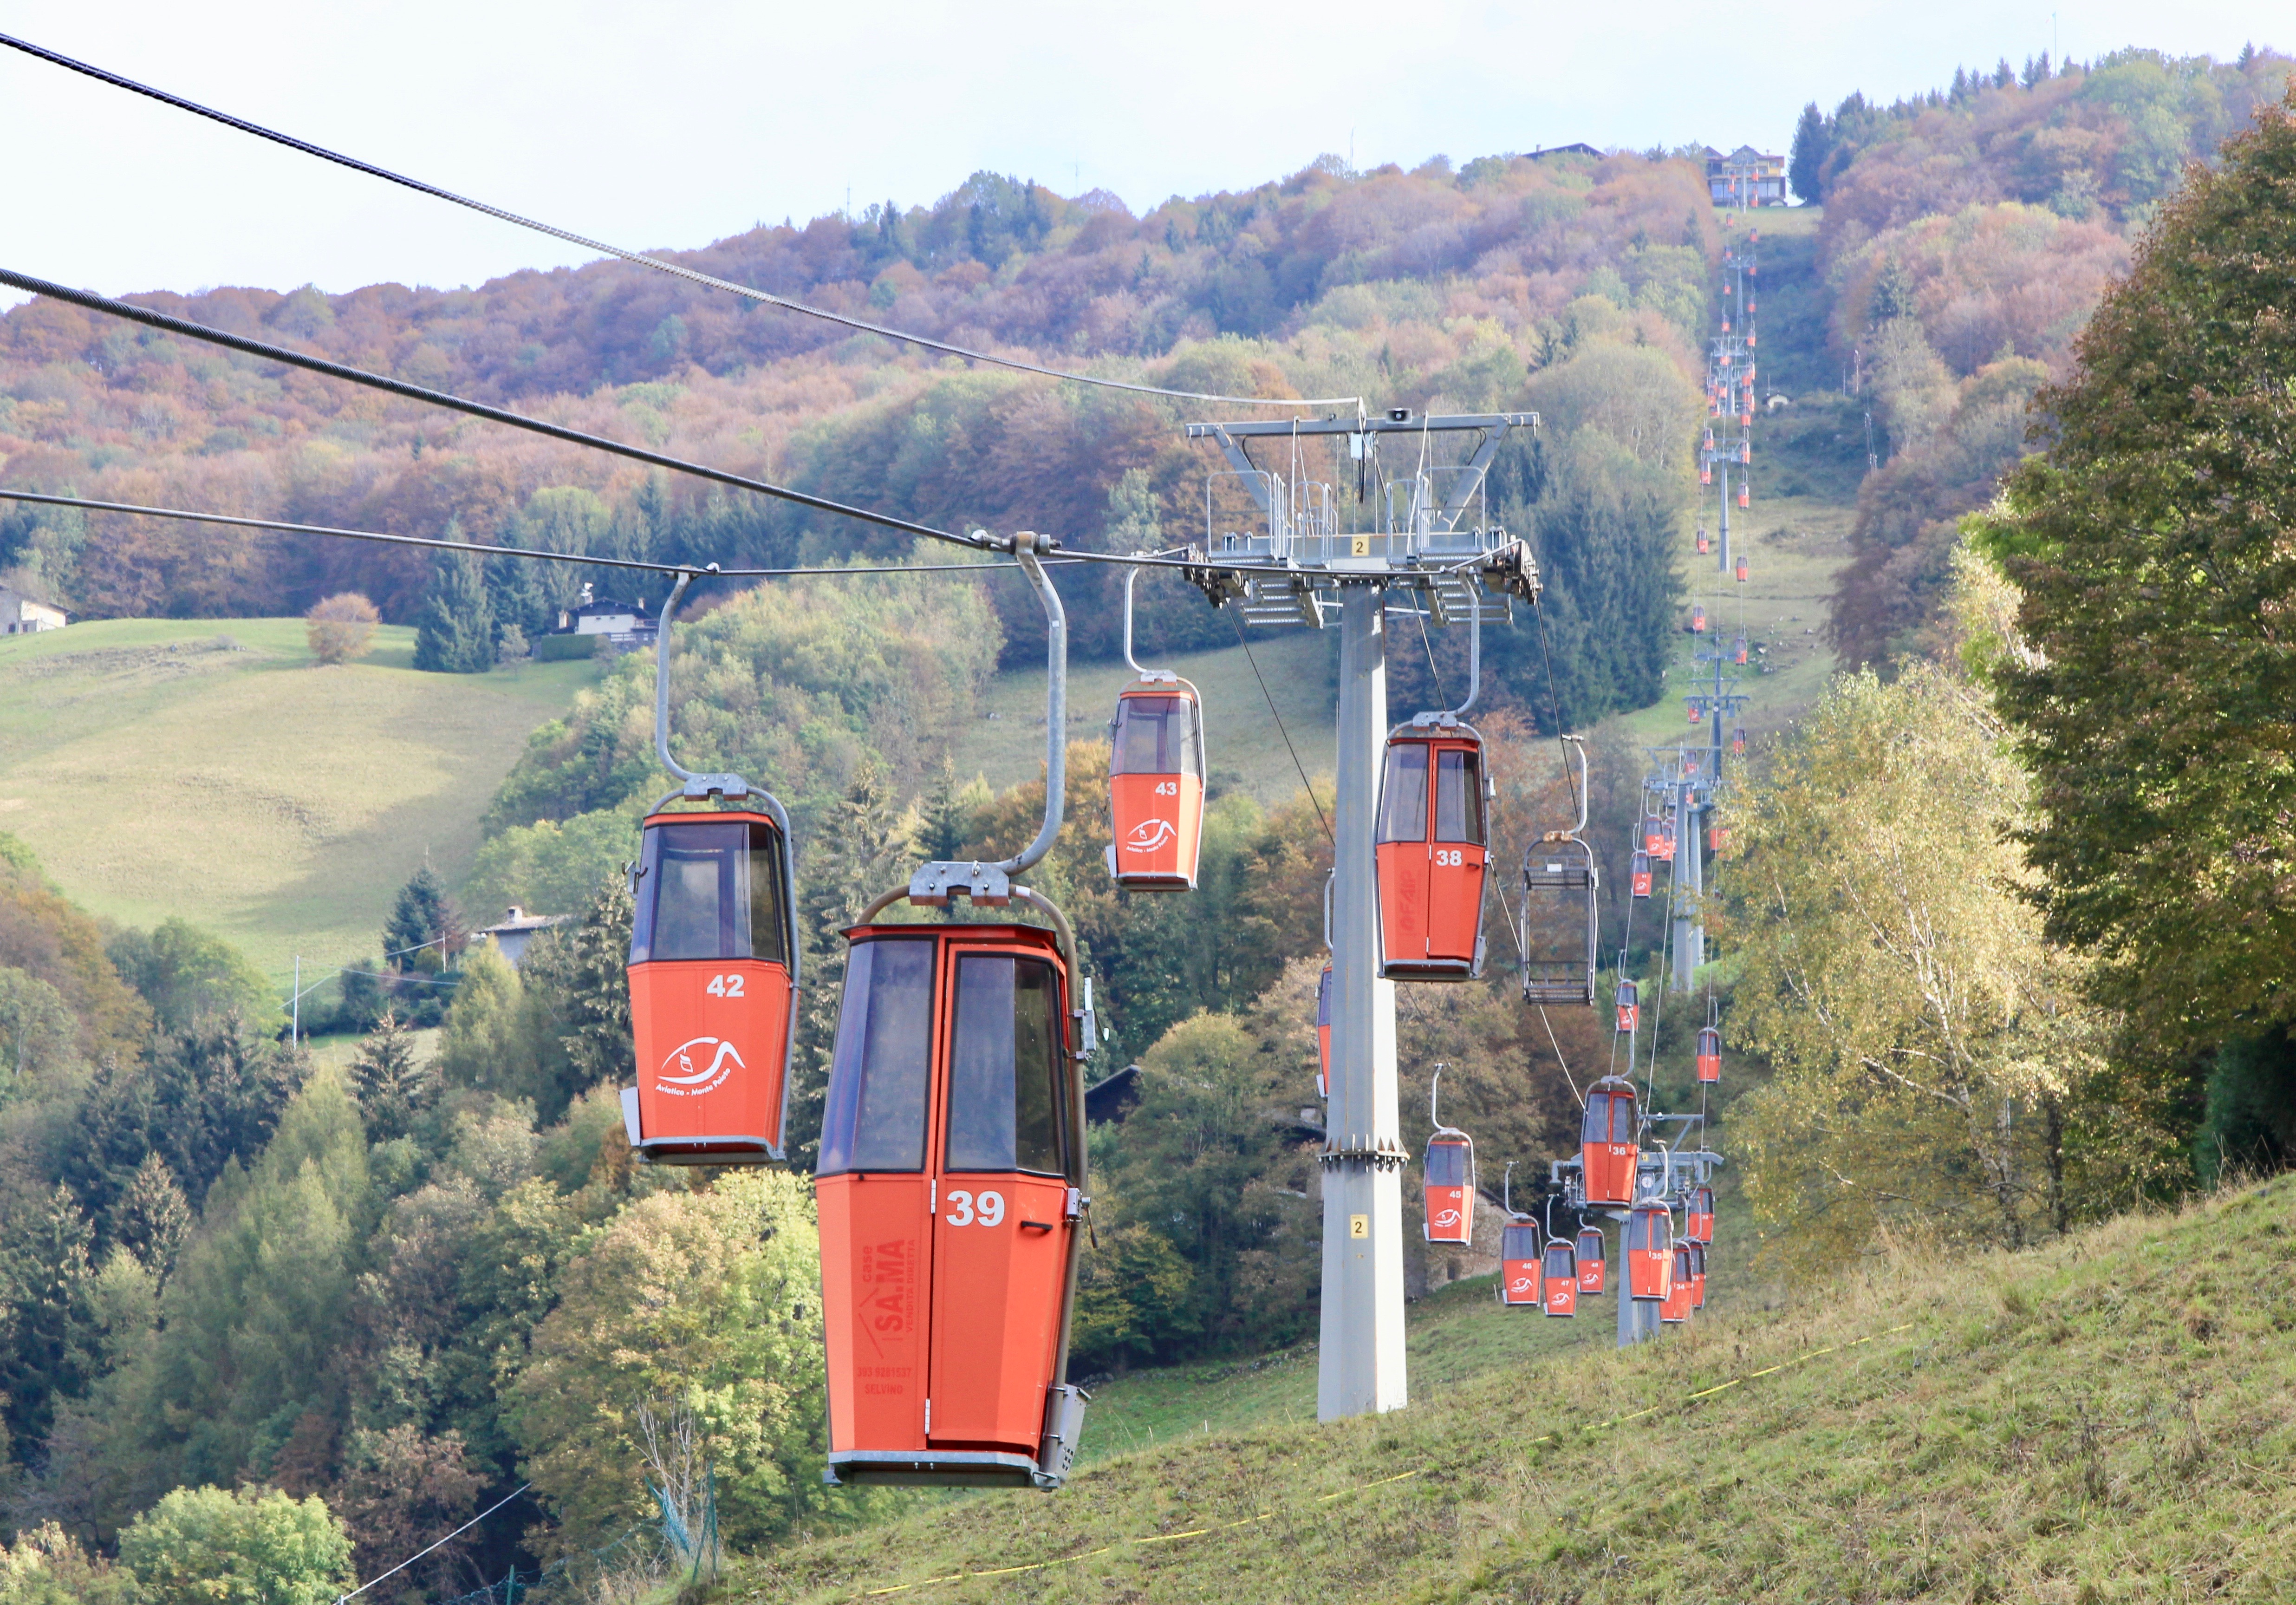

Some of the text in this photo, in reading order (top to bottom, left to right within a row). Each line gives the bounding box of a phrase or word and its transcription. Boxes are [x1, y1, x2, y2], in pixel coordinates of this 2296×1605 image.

[1356, 542, 1363, 553] 2
[1155, 782, 1177, 796] 43
[1436, 850, 1462, 866] 38
[706, 974, 744, 997] 42
[656, 1083, 685, 1096] Aviatico
[691, 1085, 713, 1096] Monte
[712, 1068, 731, 1088] Poieto
[1613, 1146, 1626, 1155] 36
[1449, 1190, 1461, 1199] 45
[945, 1190, 1005, 1227] 39
[1355, 1221, 1362, 1233] 2
[863, 1246, 872, 1283] case
[906, 1240, 915, 1284] DIRETTA
[874, 1240, 905, 1332] SA.MA
[857, 1366, 873, 1377] 393
[865, 1383, 903, 1395] SELVINO
